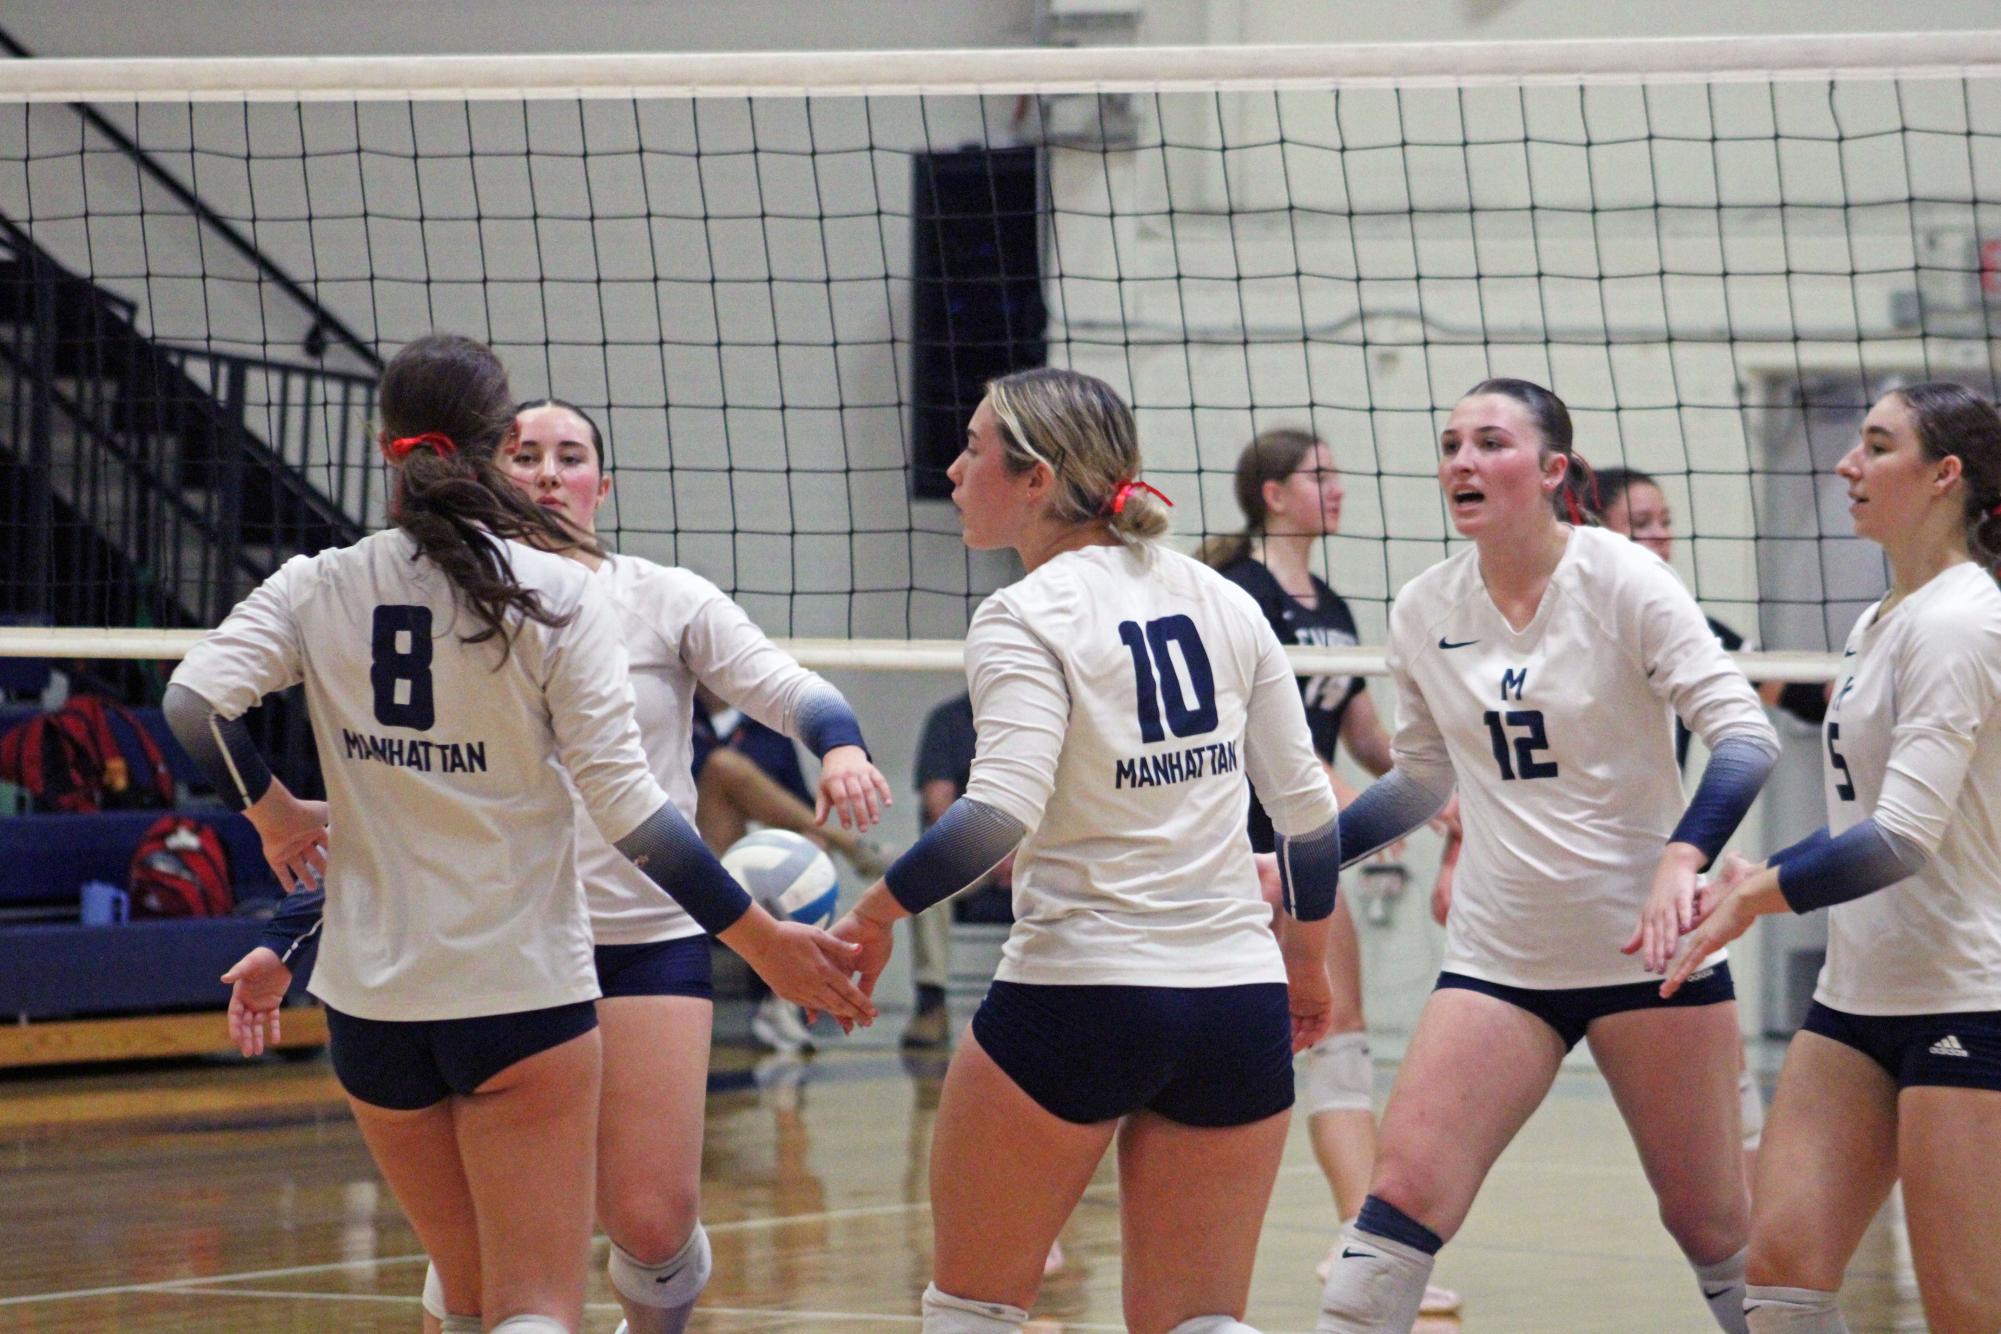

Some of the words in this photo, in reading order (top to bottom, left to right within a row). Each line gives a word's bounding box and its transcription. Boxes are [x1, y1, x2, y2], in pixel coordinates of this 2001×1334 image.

[371, 604, 435, 731] 8
[1118, 614, 1219, 744] 10
[1501, 667, 1527, 700] M
[342, 729, 487, 773] MANHATTAN
[1115, 740, 1237, 789] MANHATTAN
[1484, 710, 1558, 780] 12
[1828, 722, 1856, 801] 5
